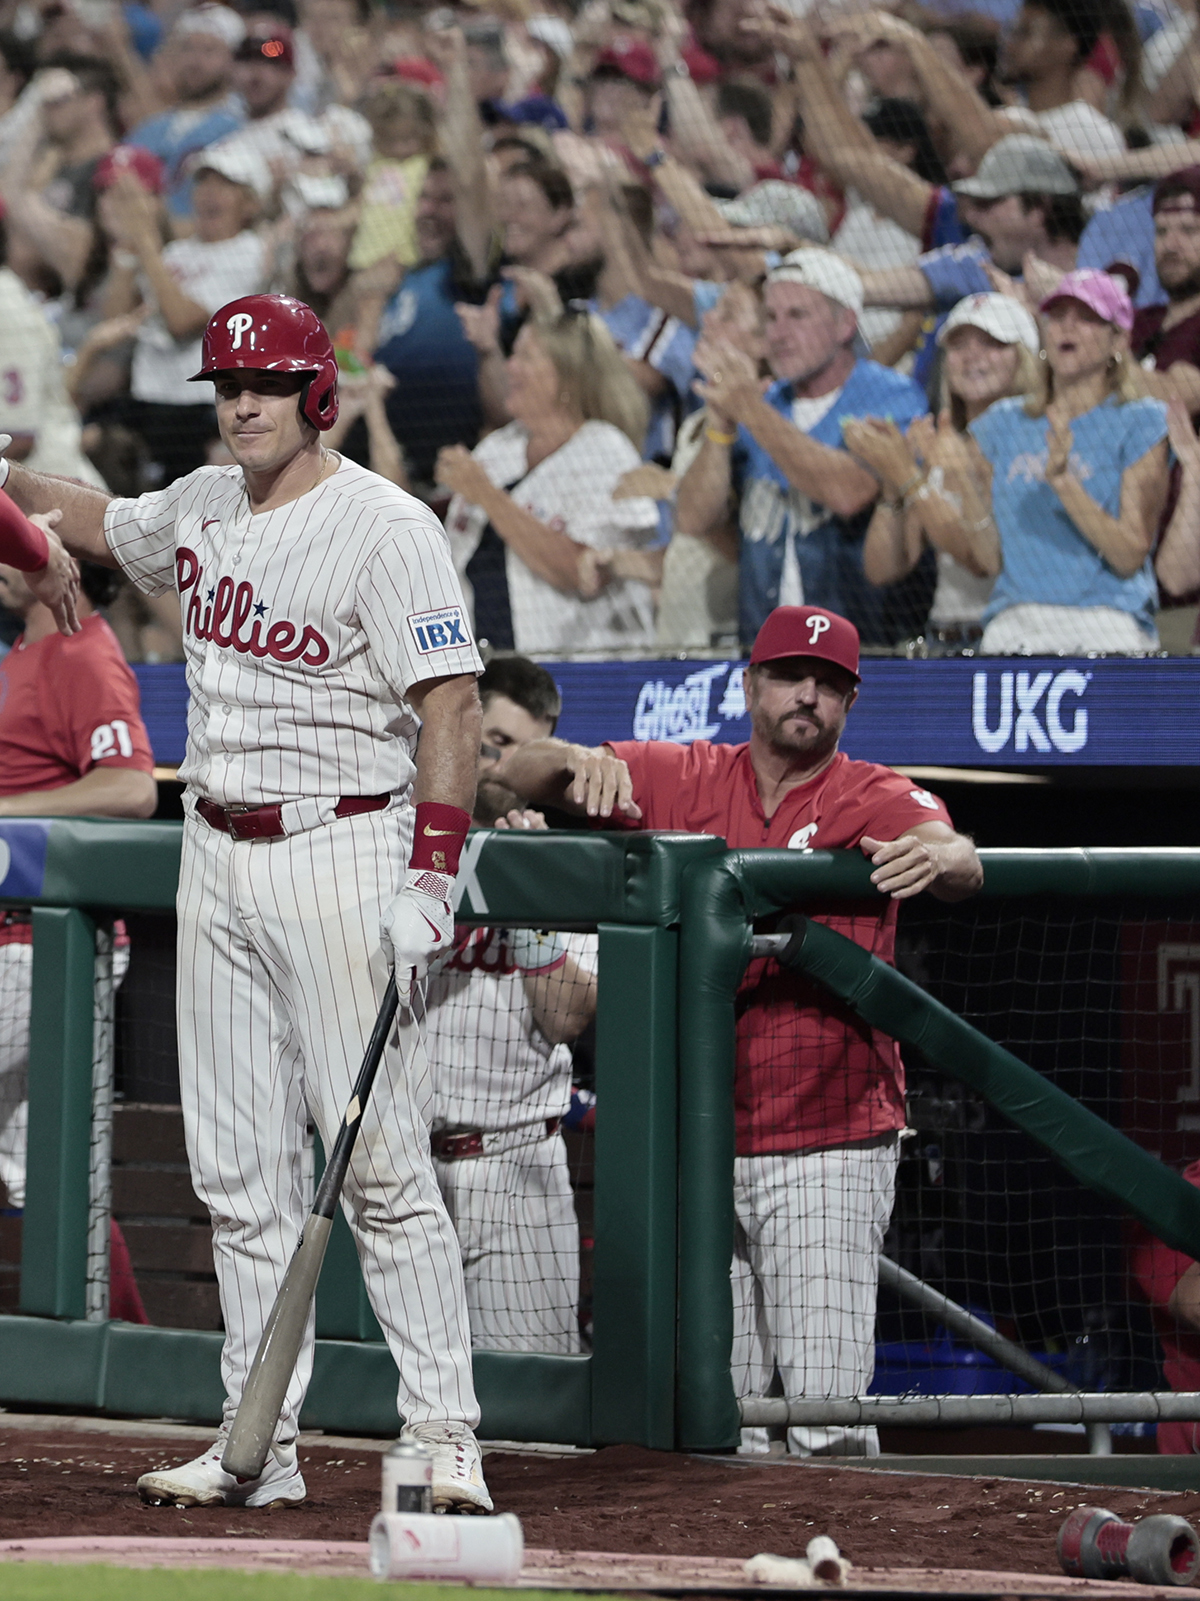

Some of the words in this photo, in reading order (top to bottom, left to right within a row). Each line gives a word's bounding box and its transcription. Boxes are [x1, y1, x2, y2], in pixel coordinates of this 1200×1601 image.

[226, 313, 253, 350] P
[176, 546, 330, 667] Phillies
[415, 619, 467, 651] IBX
[805, 615, 831, 645] P
[972, 669, 1089, 752] UKG
[91, 719, 133, 760] 21
